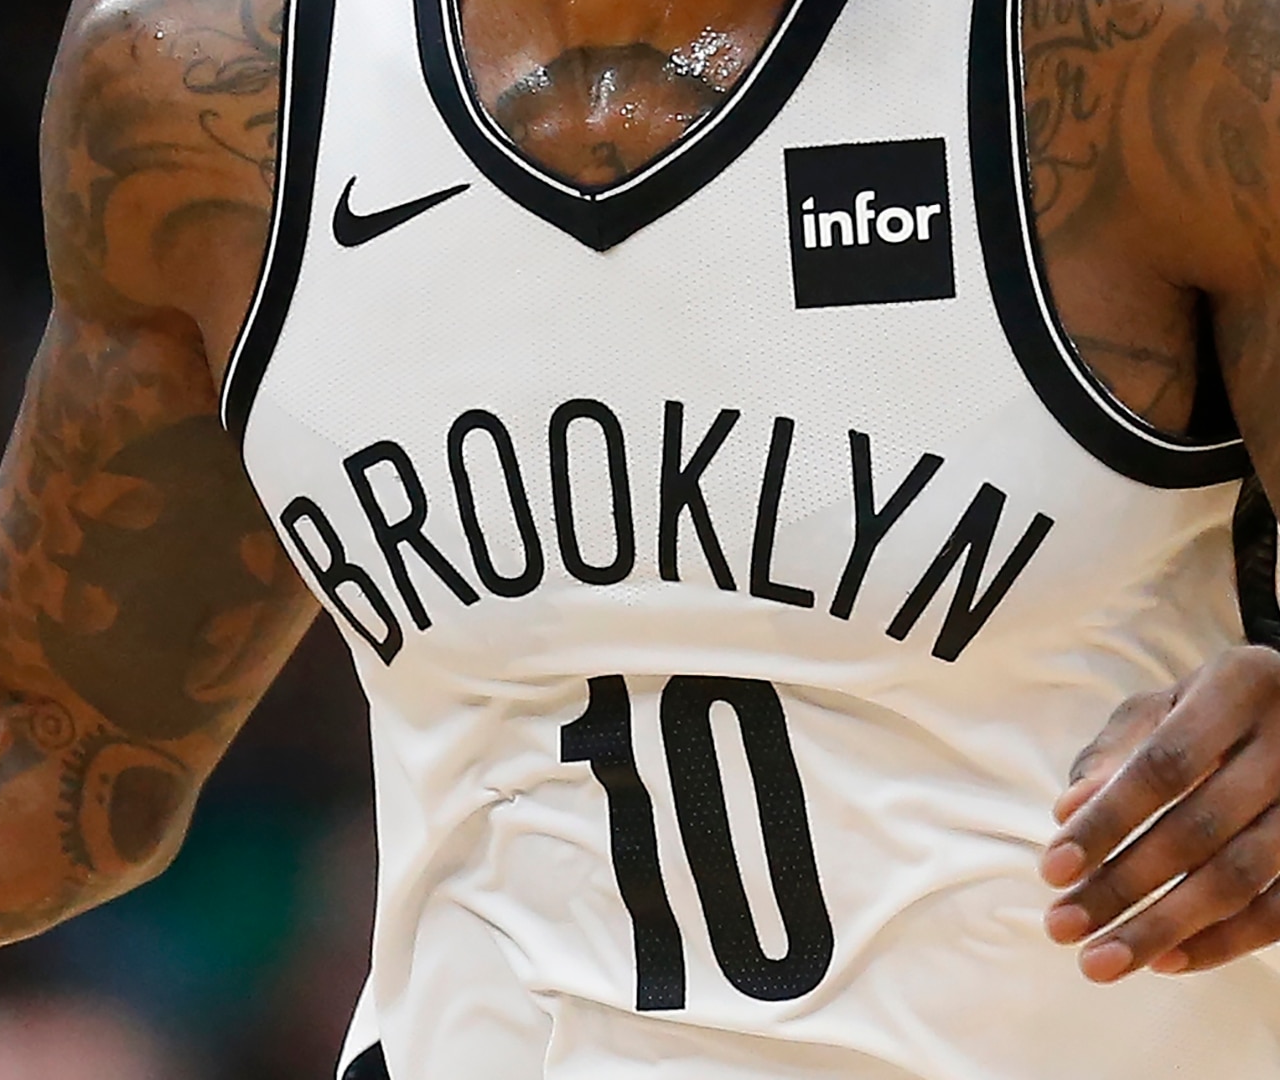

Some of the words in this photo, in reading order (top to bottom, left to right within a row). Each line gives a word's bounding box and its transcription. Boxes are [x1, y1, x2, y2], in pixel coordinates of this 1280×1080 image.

[801, 190, 942, 249] infor
[279, 399, 1054, 666] BROOKLYN
[560, 672, 835, 1010] 10
